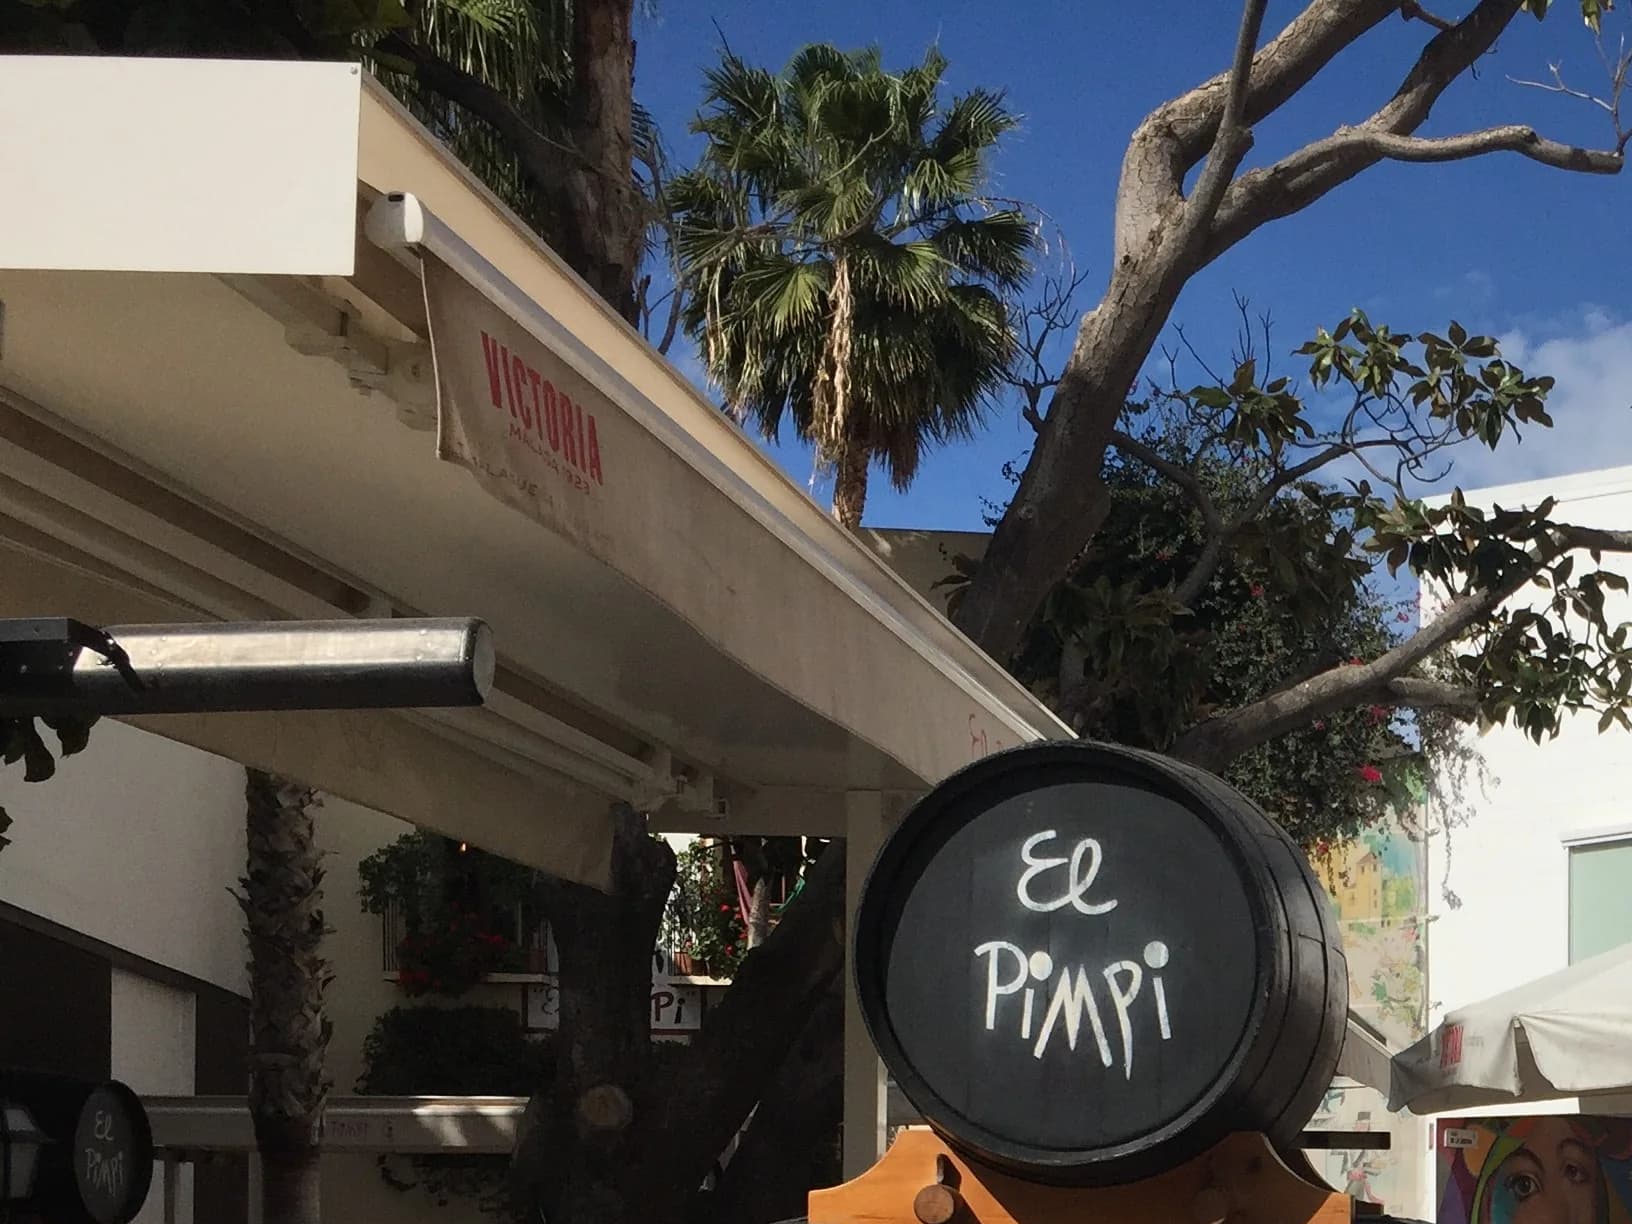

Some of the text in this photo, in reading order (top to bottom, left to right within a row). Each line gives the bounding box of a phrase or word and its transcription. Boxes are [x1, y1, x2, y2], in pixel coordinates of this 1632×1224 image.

[481, 331, 604, 486] VICTORIA
[1017, 830, 1118, 914] El
[95, 1109, 115, 1141] El
